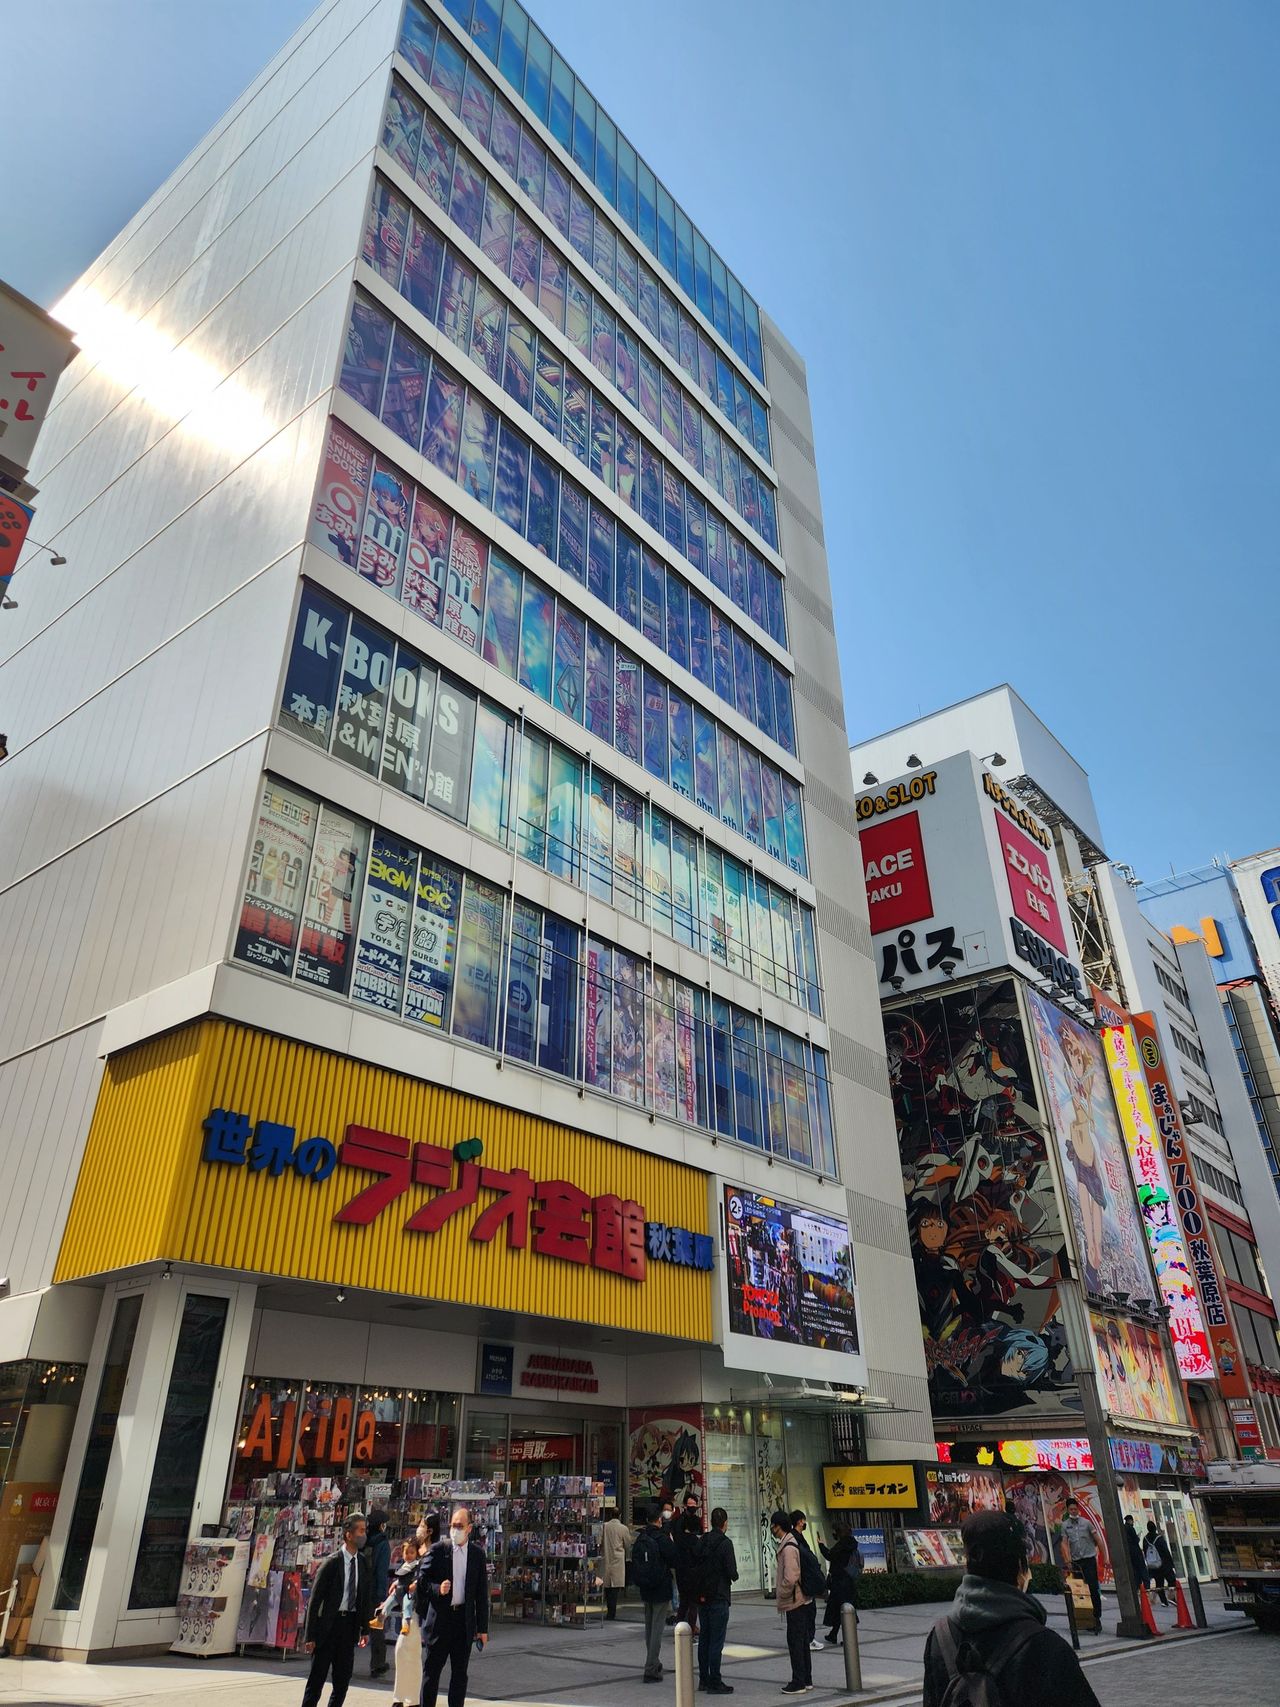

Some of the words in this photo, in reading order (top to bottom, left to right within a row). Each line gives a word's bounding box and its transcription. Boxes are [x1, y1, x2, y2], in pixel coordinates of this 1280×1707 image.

[302, 608, 460, 735] K-BOOKS
[339, 685, 421, 752] 秋葉原
[1005, 842, 1057, 902] エスパス
[370, 931, 393, 947] TOYS
[881, 926, 965, 984] パス
[1150, 1083, 1182, 1159] まぁじゃん
[202, 1107, 337, 1183] 世界の
[332, 1123, 647, 1282] ラジオ会館
[645, 1221, 715, 1272] 秋葉原
[1171, 1163, 1202, 1235] ZOO
[1189, 1238, 1227, 1327] 秋葉原店
[865, 1483, 909, 1495] ライオン
